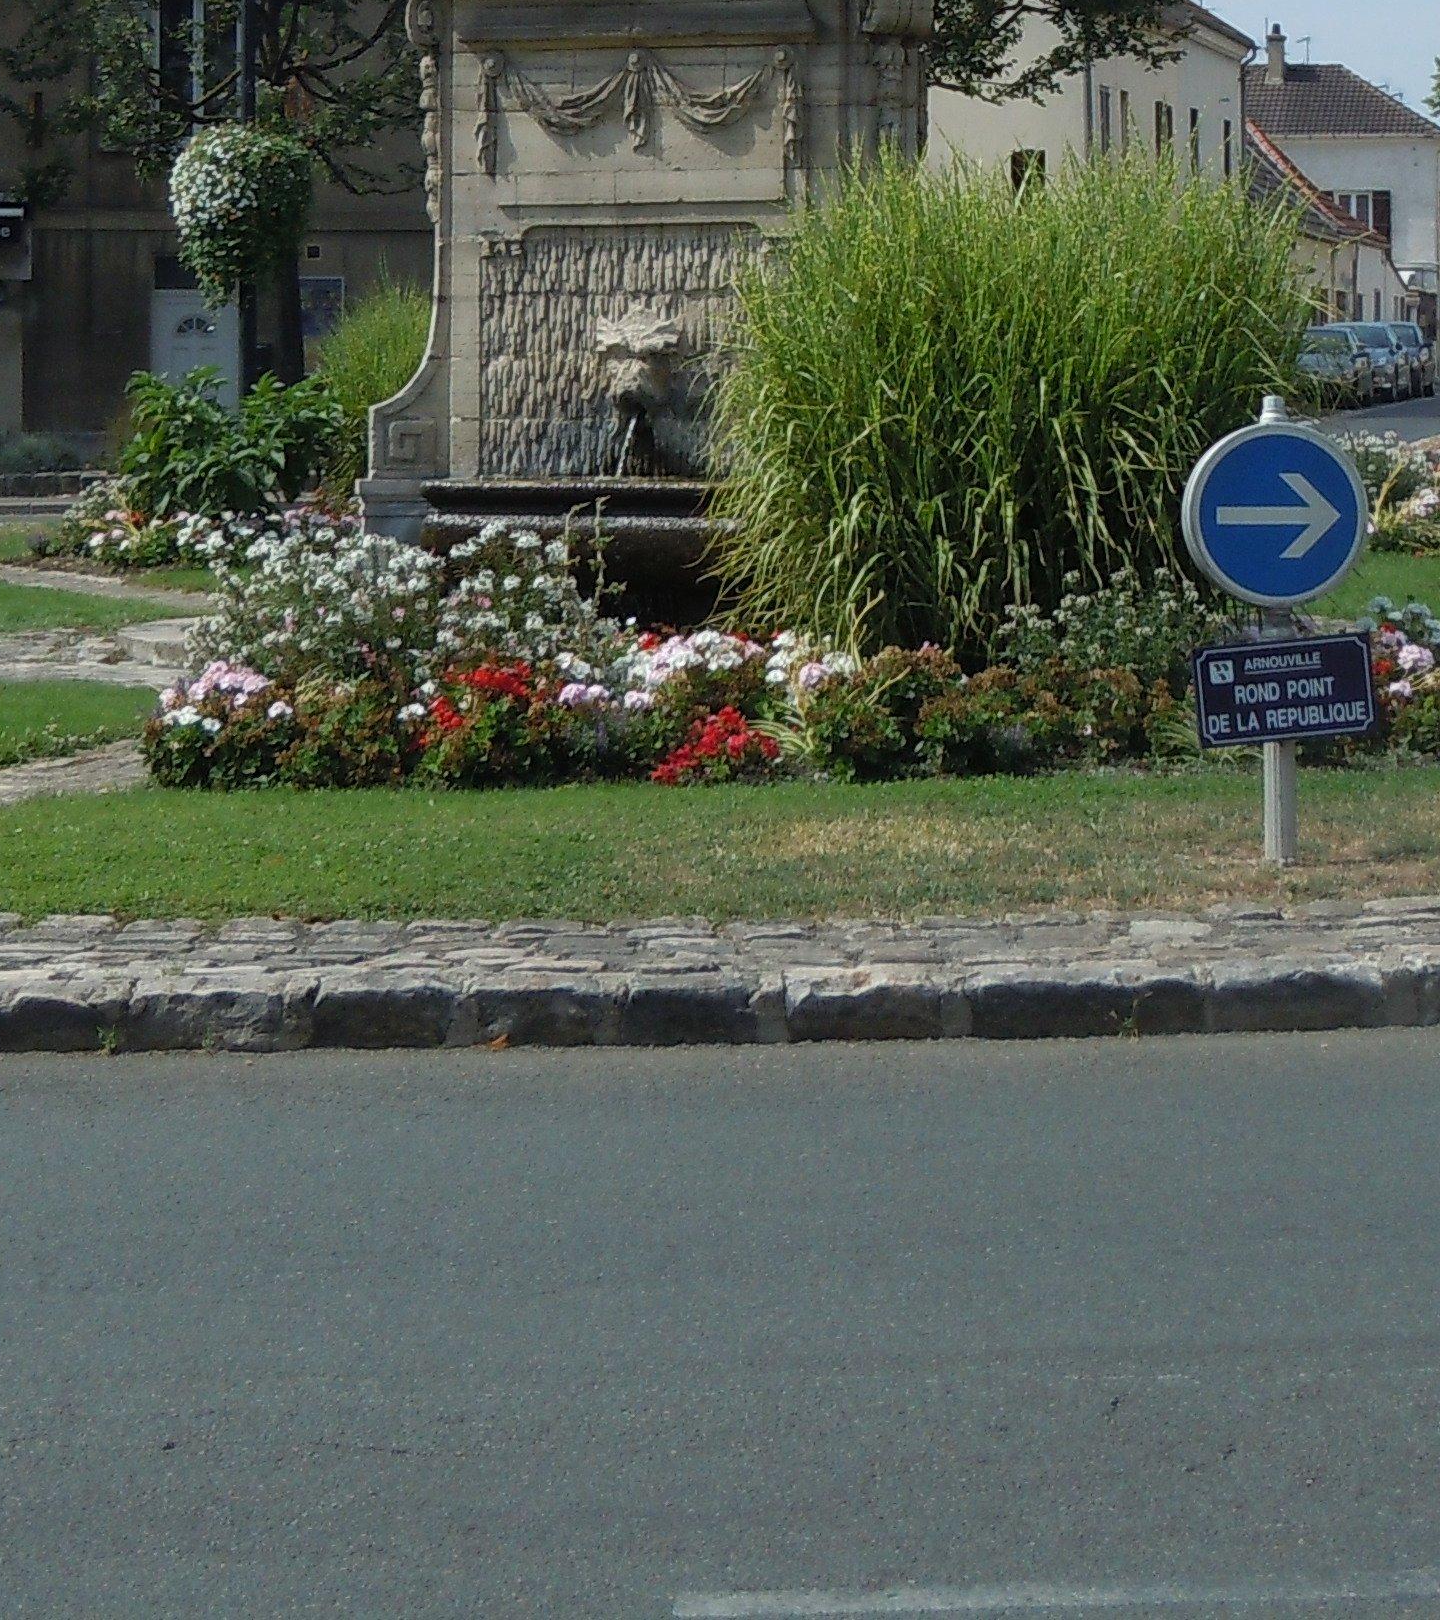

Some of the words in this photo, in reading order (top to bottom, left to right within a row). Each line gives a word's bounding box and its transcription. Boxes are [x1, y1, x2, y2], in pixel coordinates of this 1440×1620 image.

[1245, 651, 1321, 671] ARNOUVILLE
[1234, 681, 1280, 705] ROND
[1287, 676, 1335, 699] POINT
[1208, 714, 1231, 734] DE
[1237, 711, 1260, 731] LA
[1266, 700, 1367, 729] REPUBLIQUE
